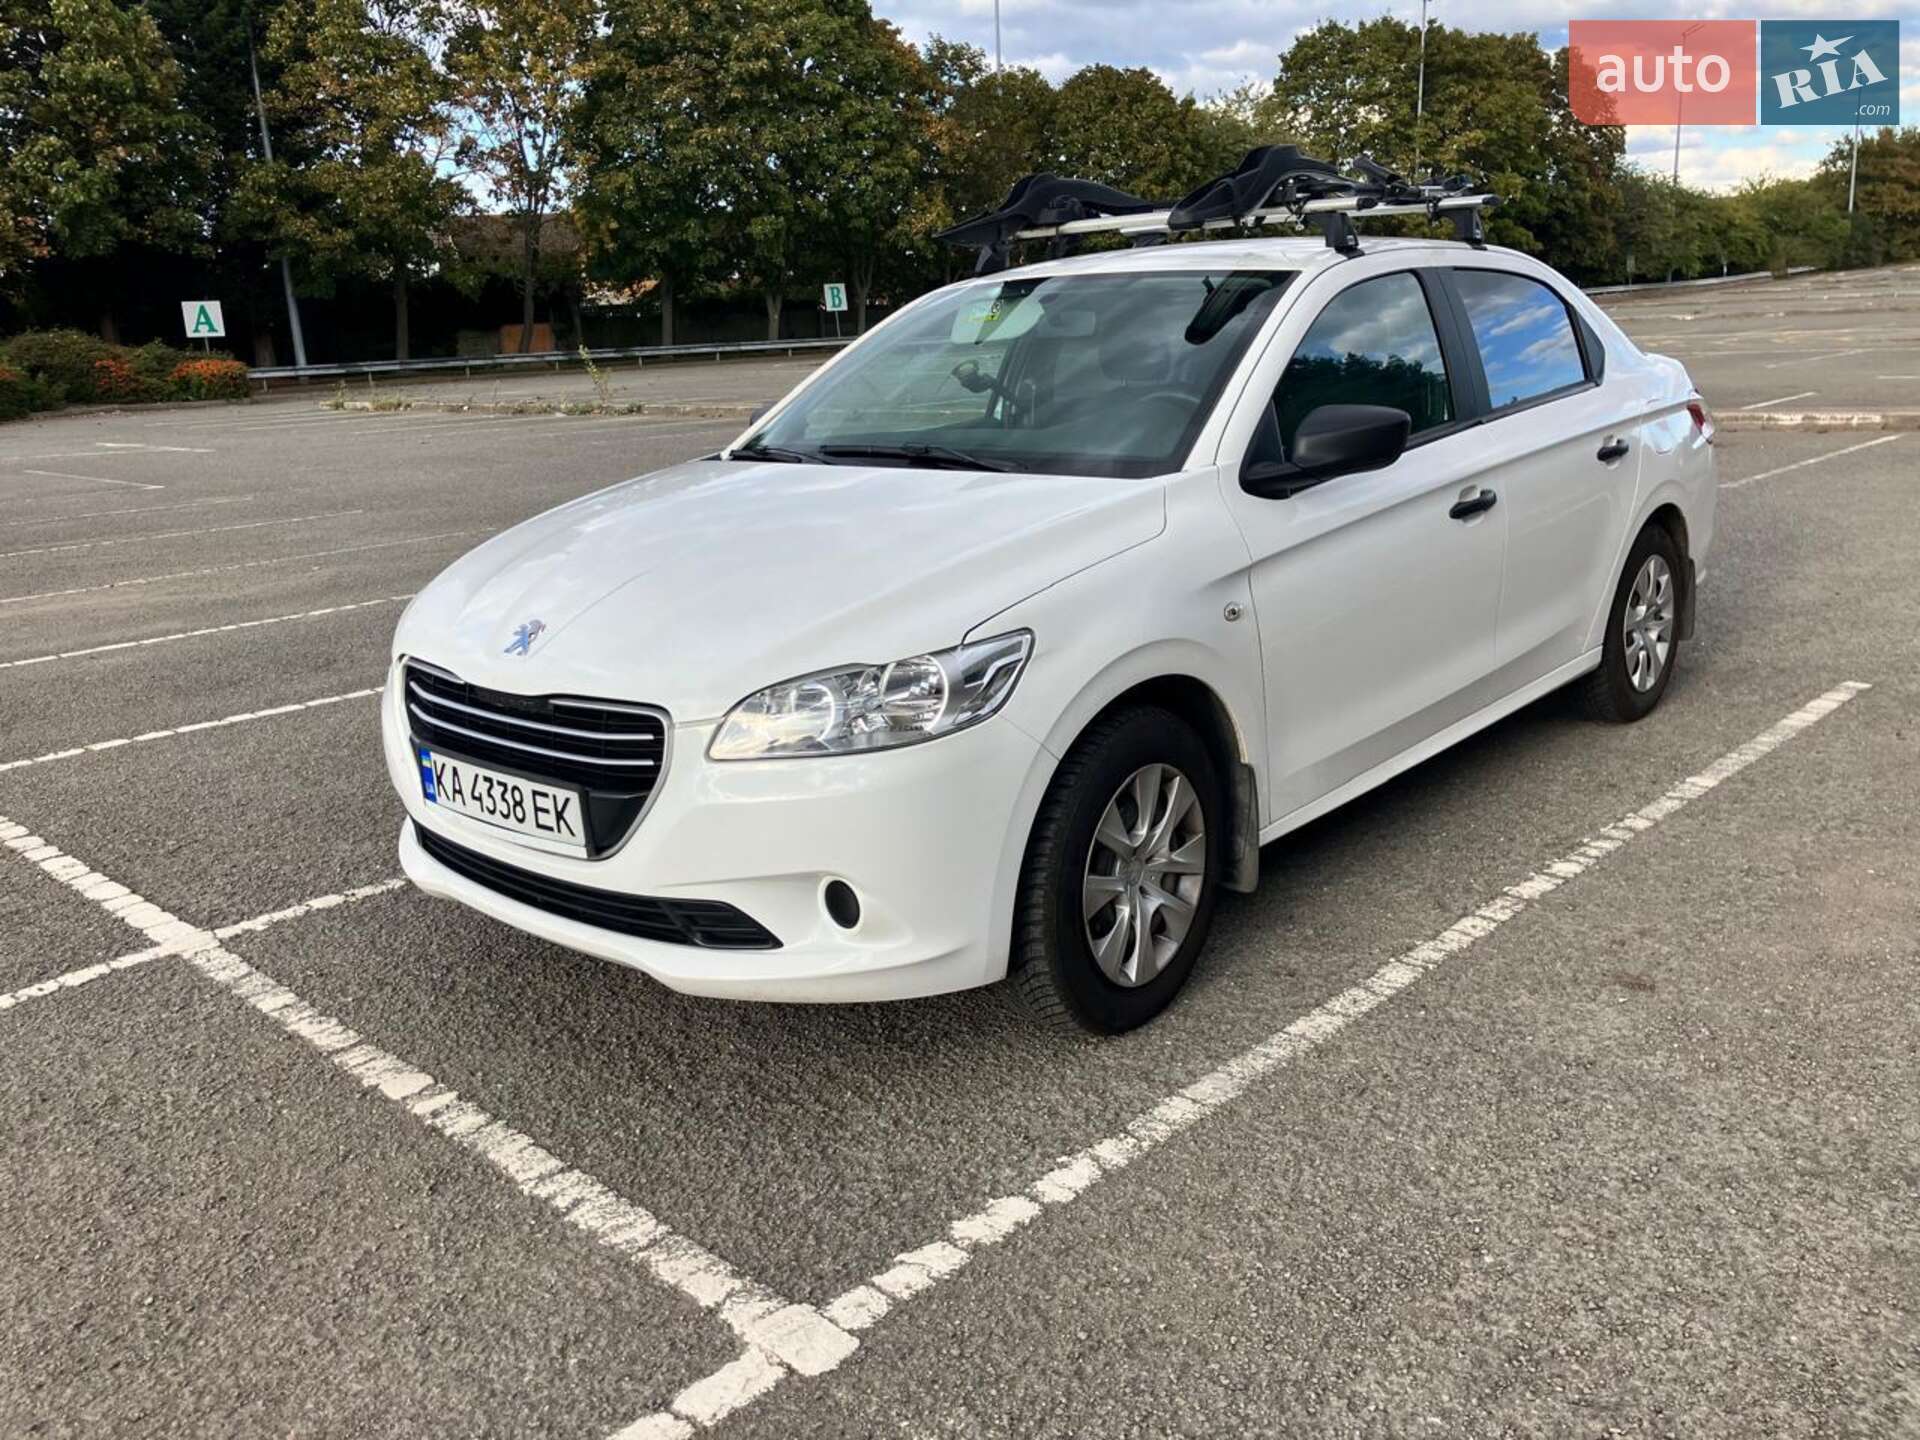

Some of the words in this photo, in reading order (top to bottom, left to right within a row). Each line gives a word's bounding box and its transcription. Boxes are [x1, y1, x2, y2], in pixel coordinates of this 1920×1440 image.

[829, 286, 842, 308] B
[192, 304, 219, 334] A
[433, 759, 466, 806] KA
[470, 773, 527, 825] 4338
[531, 788, 576, 838] EK
